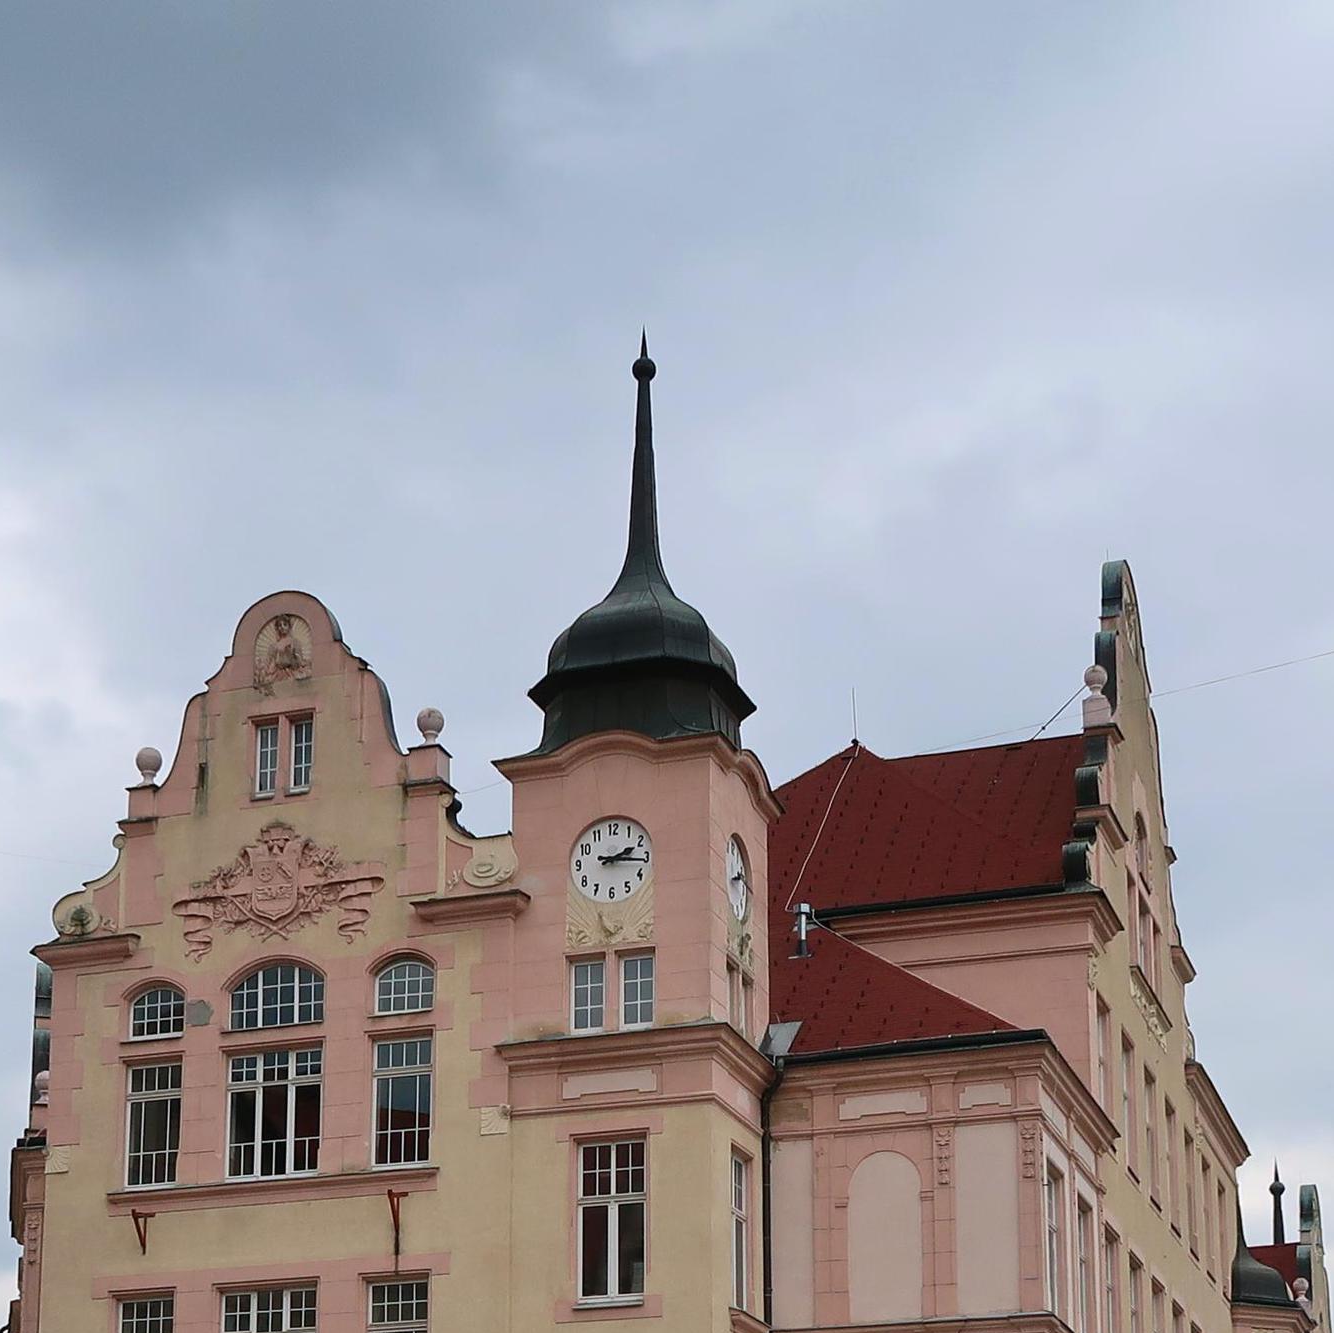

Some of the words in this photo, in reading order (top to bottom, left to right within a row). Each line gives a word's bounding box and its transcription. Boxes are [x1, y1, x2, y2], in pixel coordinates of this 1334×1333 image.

[592, 829, 601, 843] 11
[607, 823, 620, 837] 12
[637, 835, 645, 848] 2
[580, 843, 592, 857] 10
[643, 851, 650, 864] 3
[575, 859, 582, 872] 9
[581, 875, 588, 888] 8
[637, 868, 644, 882] 4
[593, 884, 600, 897] 7
[608, 887, 616, 900] 6
[624, 881, 632, 894] 5
